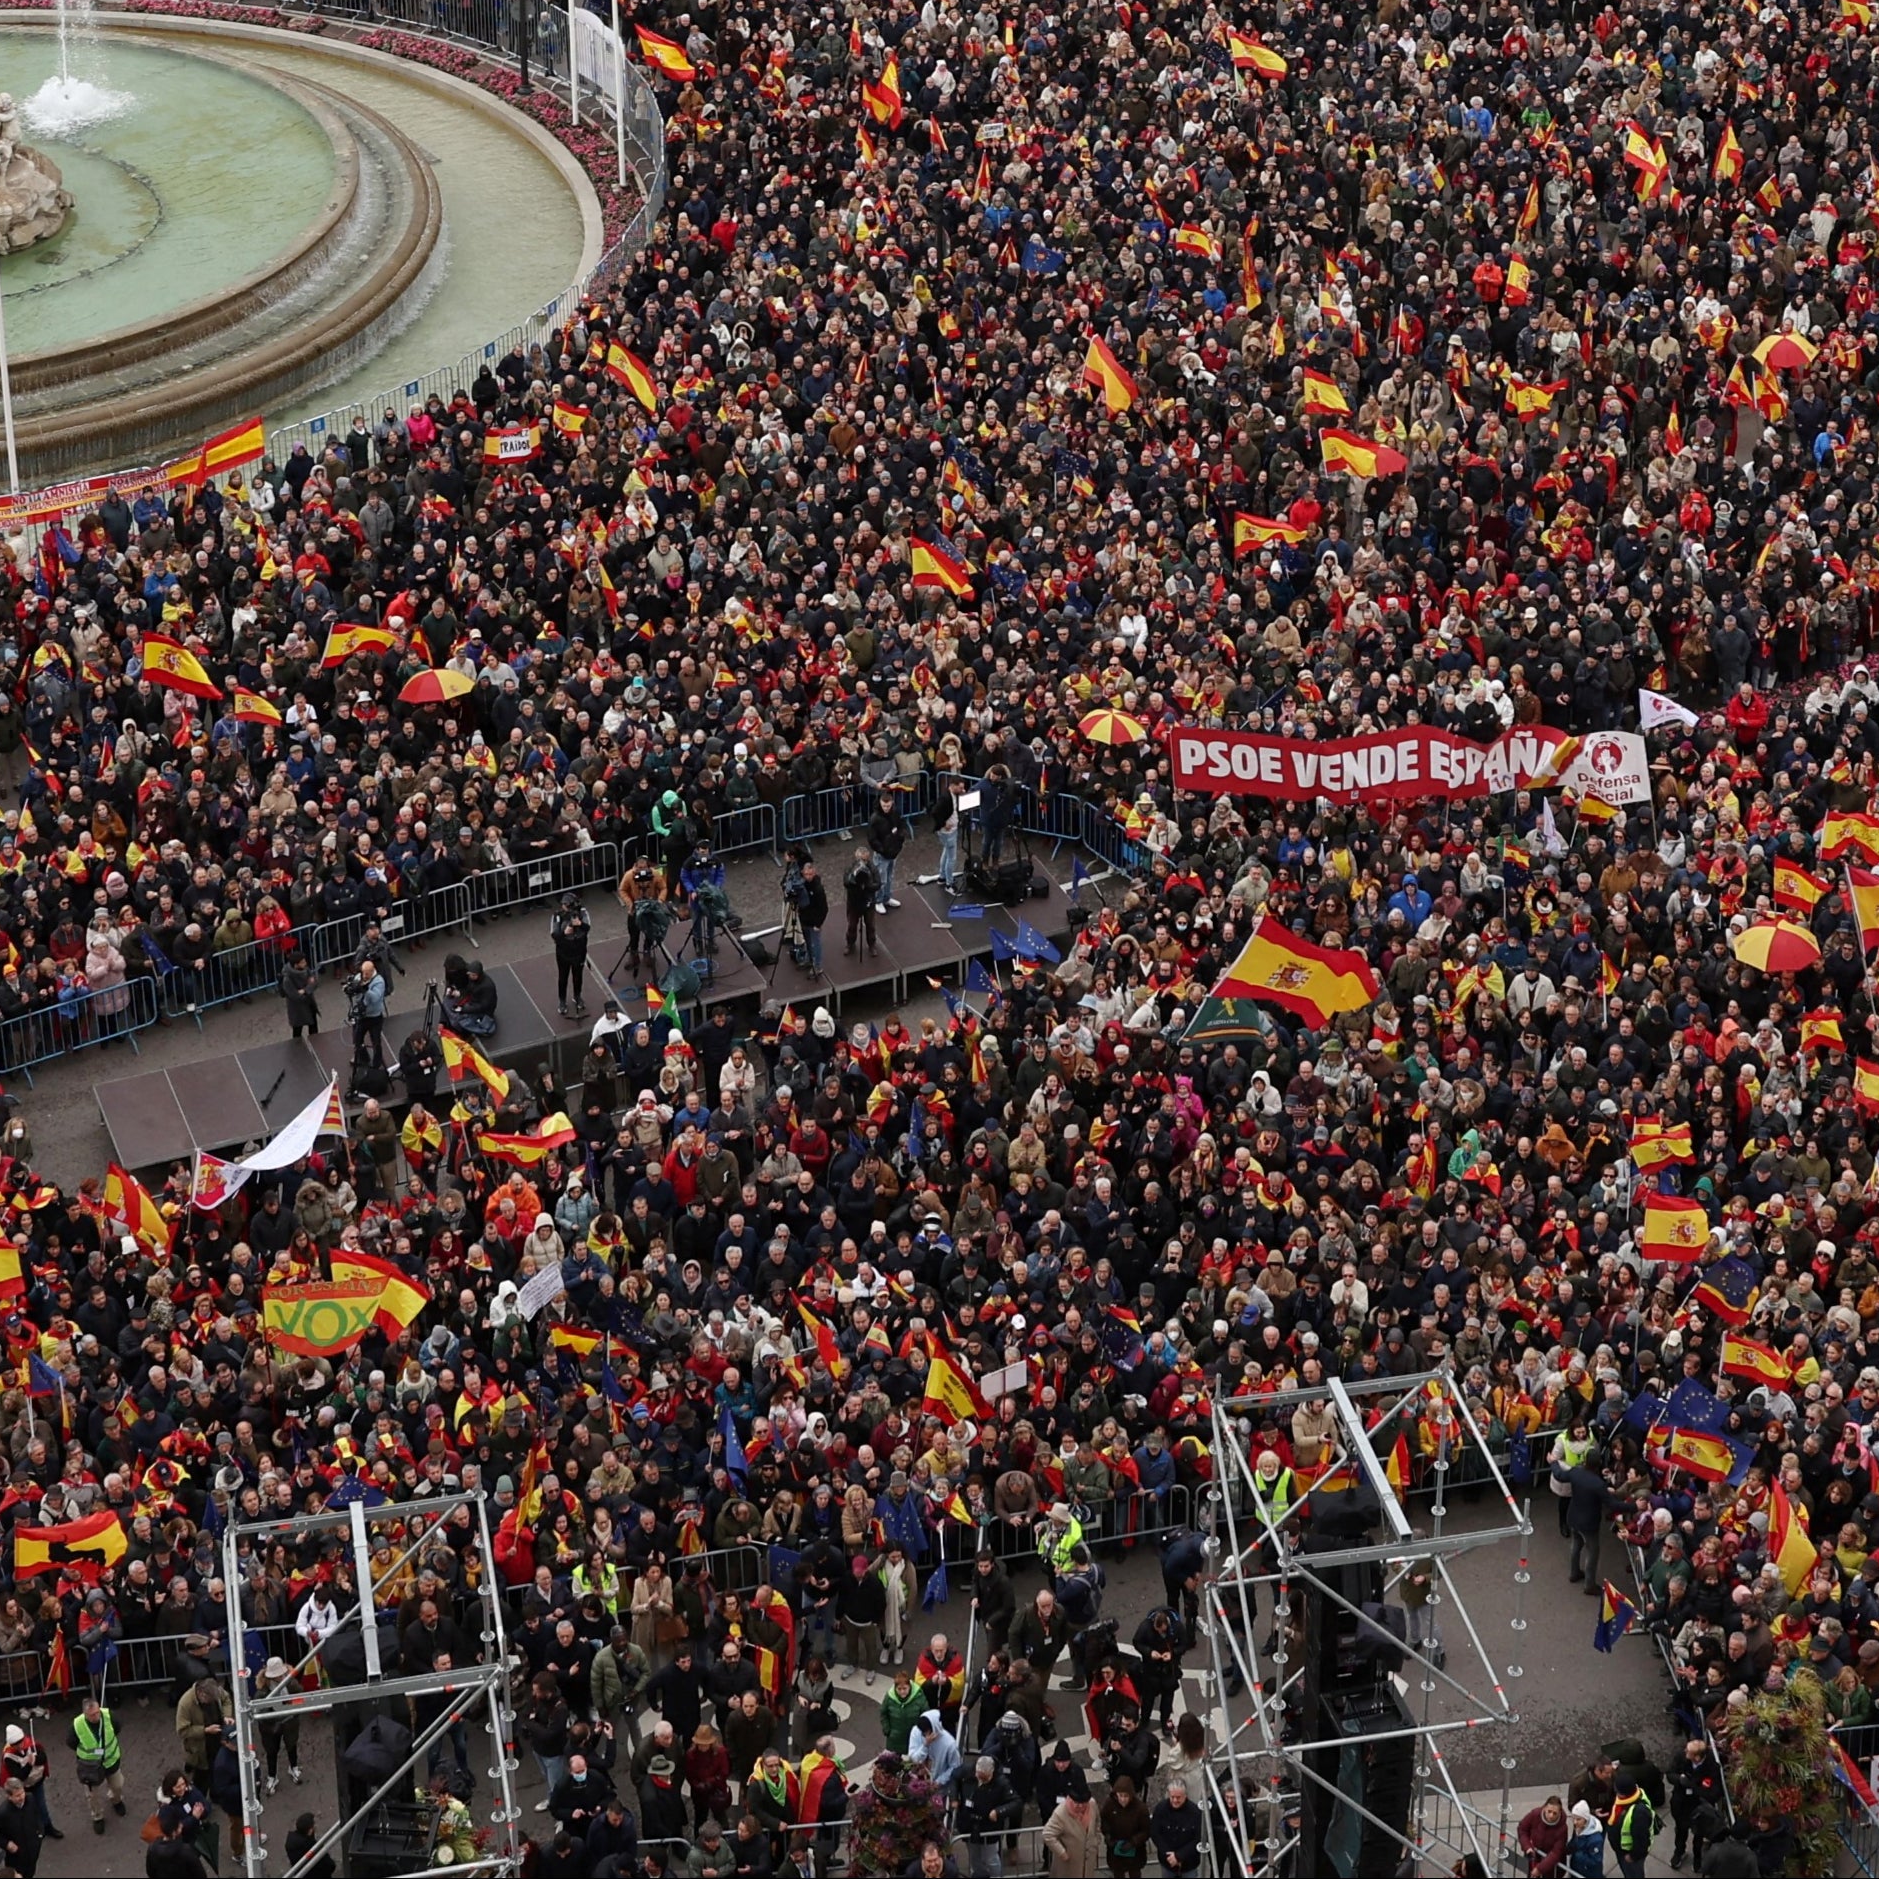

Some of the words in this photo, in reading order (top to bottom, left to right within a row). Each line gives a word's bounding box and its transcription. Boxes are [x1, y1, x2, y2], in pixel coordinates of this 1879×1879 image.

[1179, 738, 1284, 784] PSOE
[1290, 739, 1420, 792] VENDE
[1577, 772, 1641, 789] Defensa
[310, 1278, 384, 1294] ESPAÑA
[273, 1298, 379, 1347] VOX
